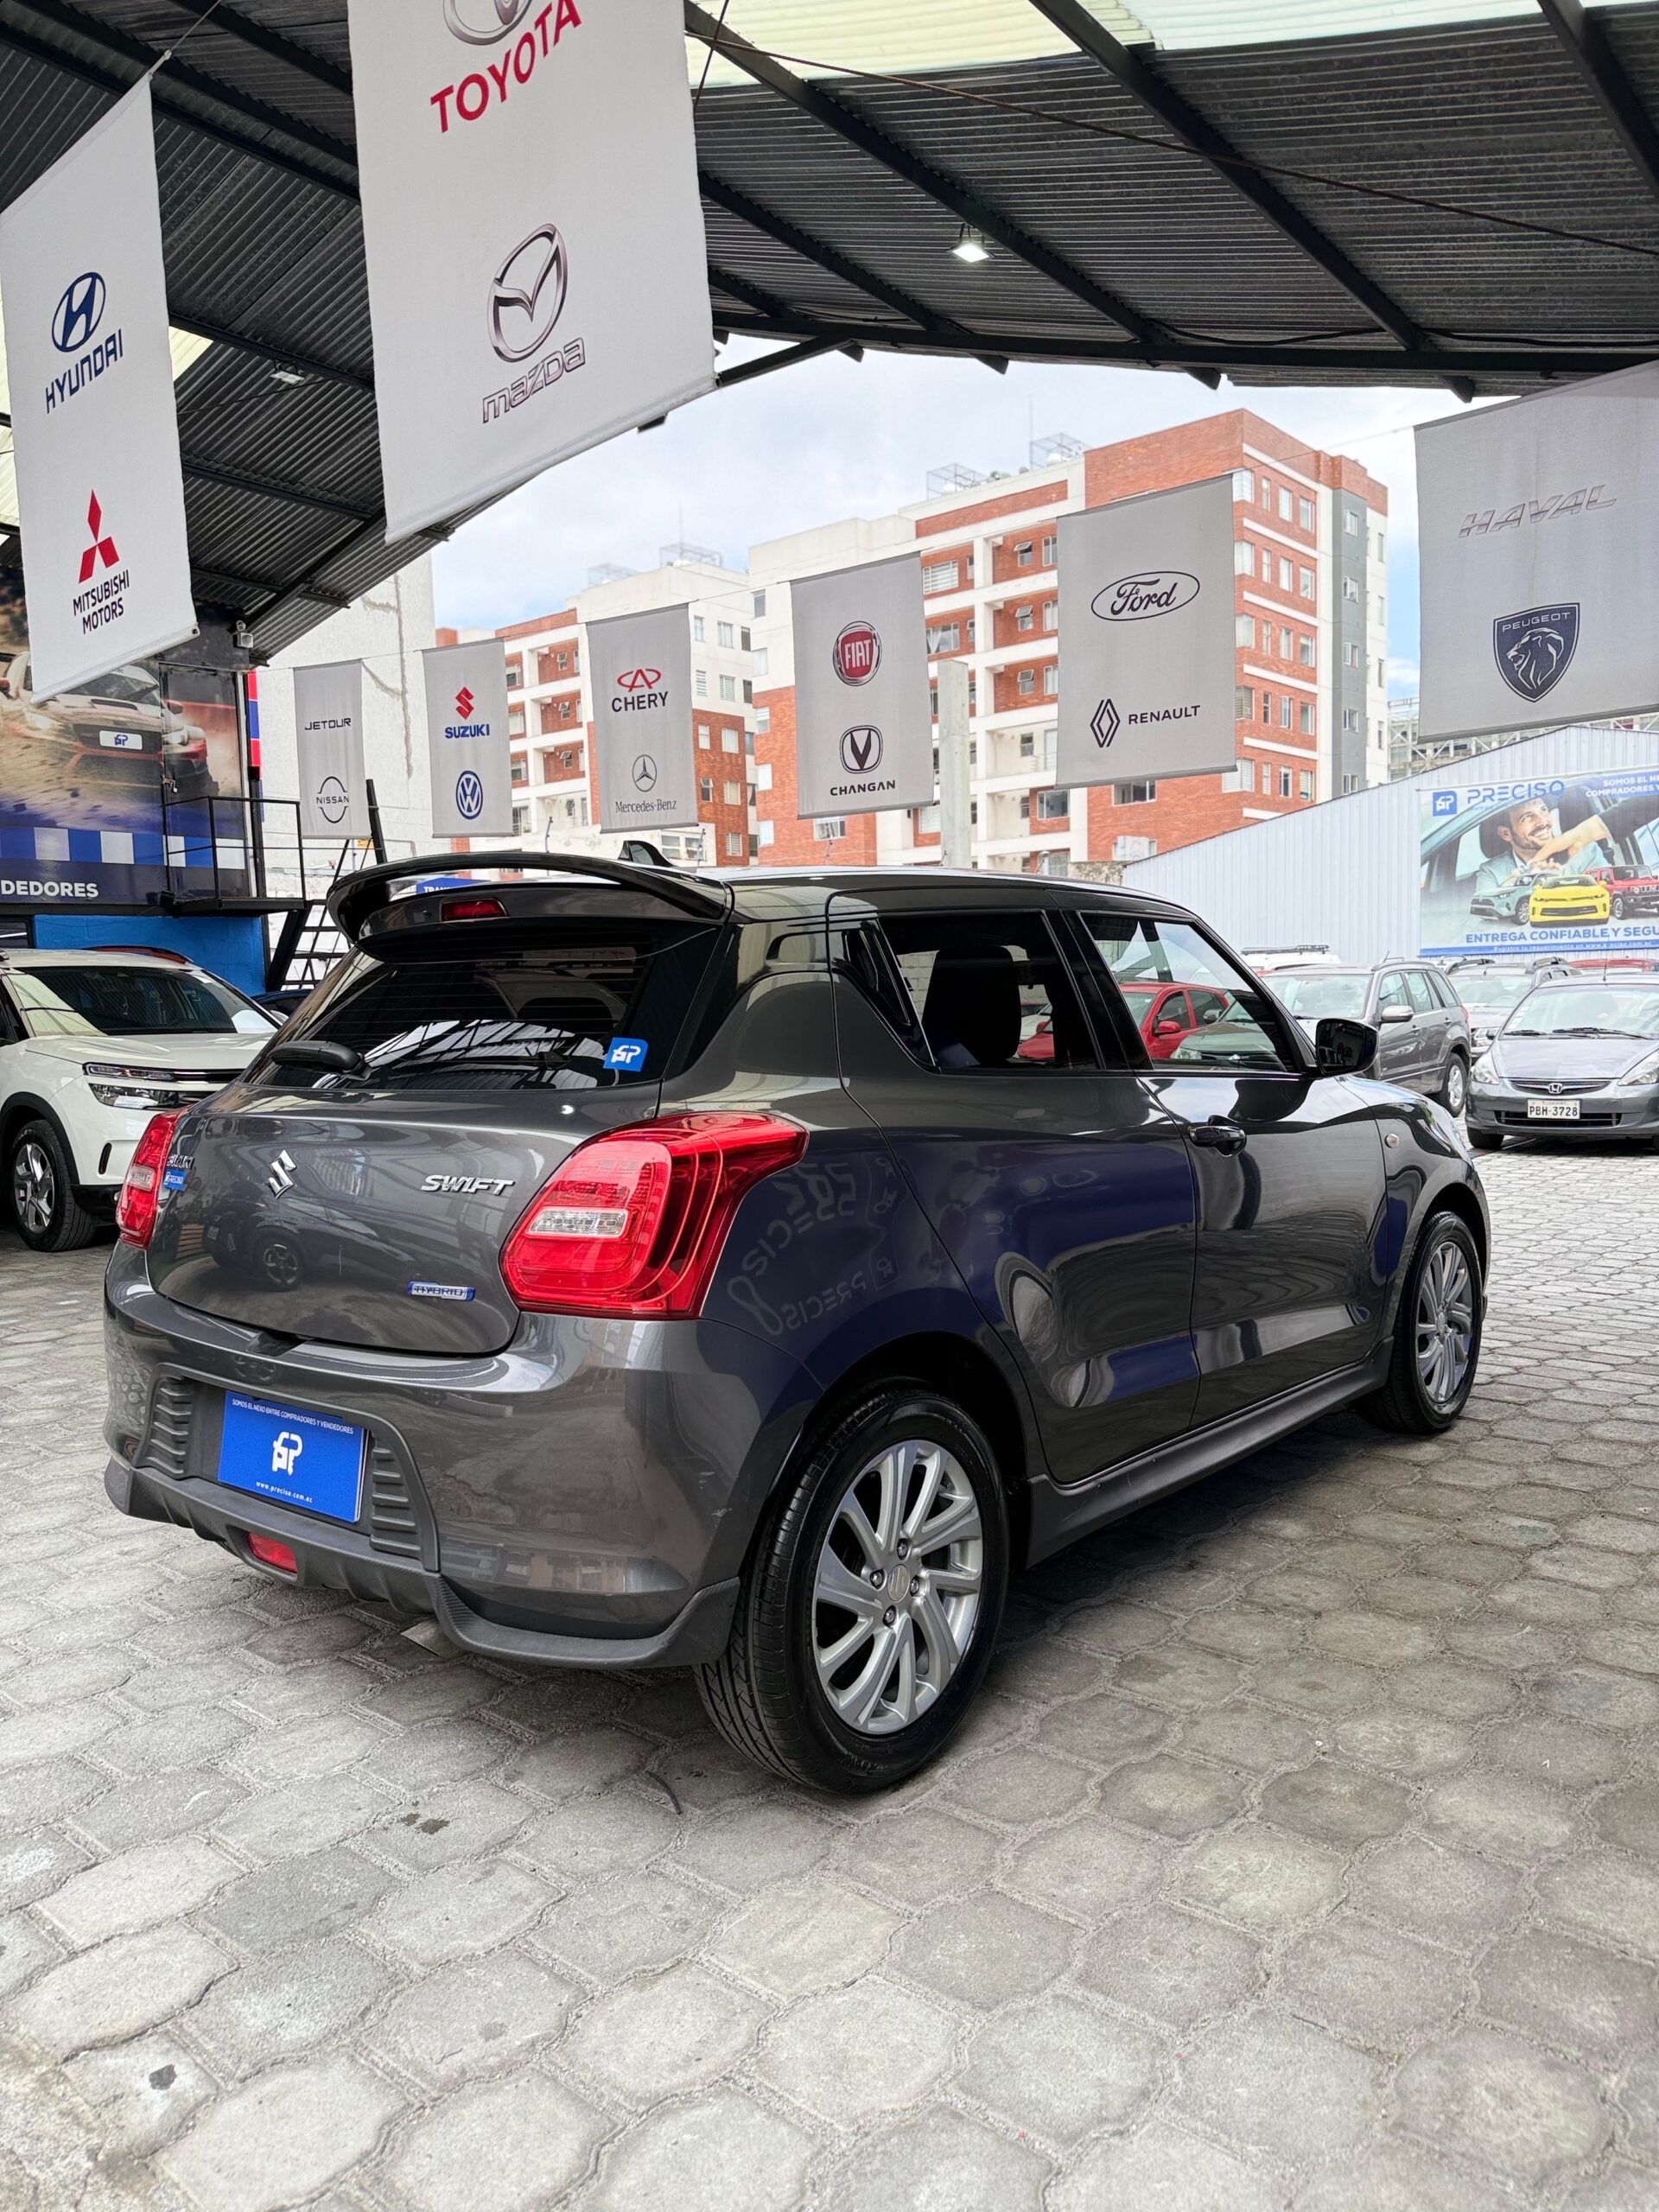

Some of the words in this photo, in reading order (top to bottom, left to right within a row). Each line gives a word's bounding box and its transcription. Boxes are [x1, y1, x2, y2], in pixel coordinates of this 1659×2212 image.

[430, 0, 582, 133] TOYOTA
[45, 328, 124, 414] HYUNDAI
[483, 337, 586, 423] mazda
[1459, 484, 1617, 538] HAVAL
[73, 569, 130, 616] MITSUBISHI
[1110, 578, 1178, 615] Ford
[82, 596, 124, 635] MOTORS
[1502, 612, 1571, 632] PEUGEOT
[844, 639, 872, 670] FIAT
[612, 691, 669, 713] CHERY
[304, 717, 351, 730] JETOUR
[1128, 705, 1200, 725] RENAULT
[444, 723, 490, 739] SUZUKI
[830, 779, 895, 796] CHANGAN
[1467, 780, 1565, 804] PRECISO
[1586, 785, 1654, 797] COMPRADORES
[1603, 778, 1635, 786] SOMOS
[316, 795, 349, 804] NISSAN
[615, 798, 677, 813] Mercedes-Benz
[1, 880, 99, 898] DEDORES
[1465, 931, 1528, 944] ENTREGA
[1529, 928, 1609, 941] CONFIABLE
[1611, 927, 1620, 938] Y
[1529, 1106, 1578, 1116] PBH-3728
[421, 1174, 516, 1196] SWIFT
[414, 1286, 464, 1297] HYBRID
[232, 1398, 248, 1408] SOMOS
[253, 1404, 265, 1414] NEXO
[265, 1408, 281, 1417] ENTRE
[280, 1411, 316, 1426] COMPRADORES
[321, 1421, 354, 1434] VENDEDORES
